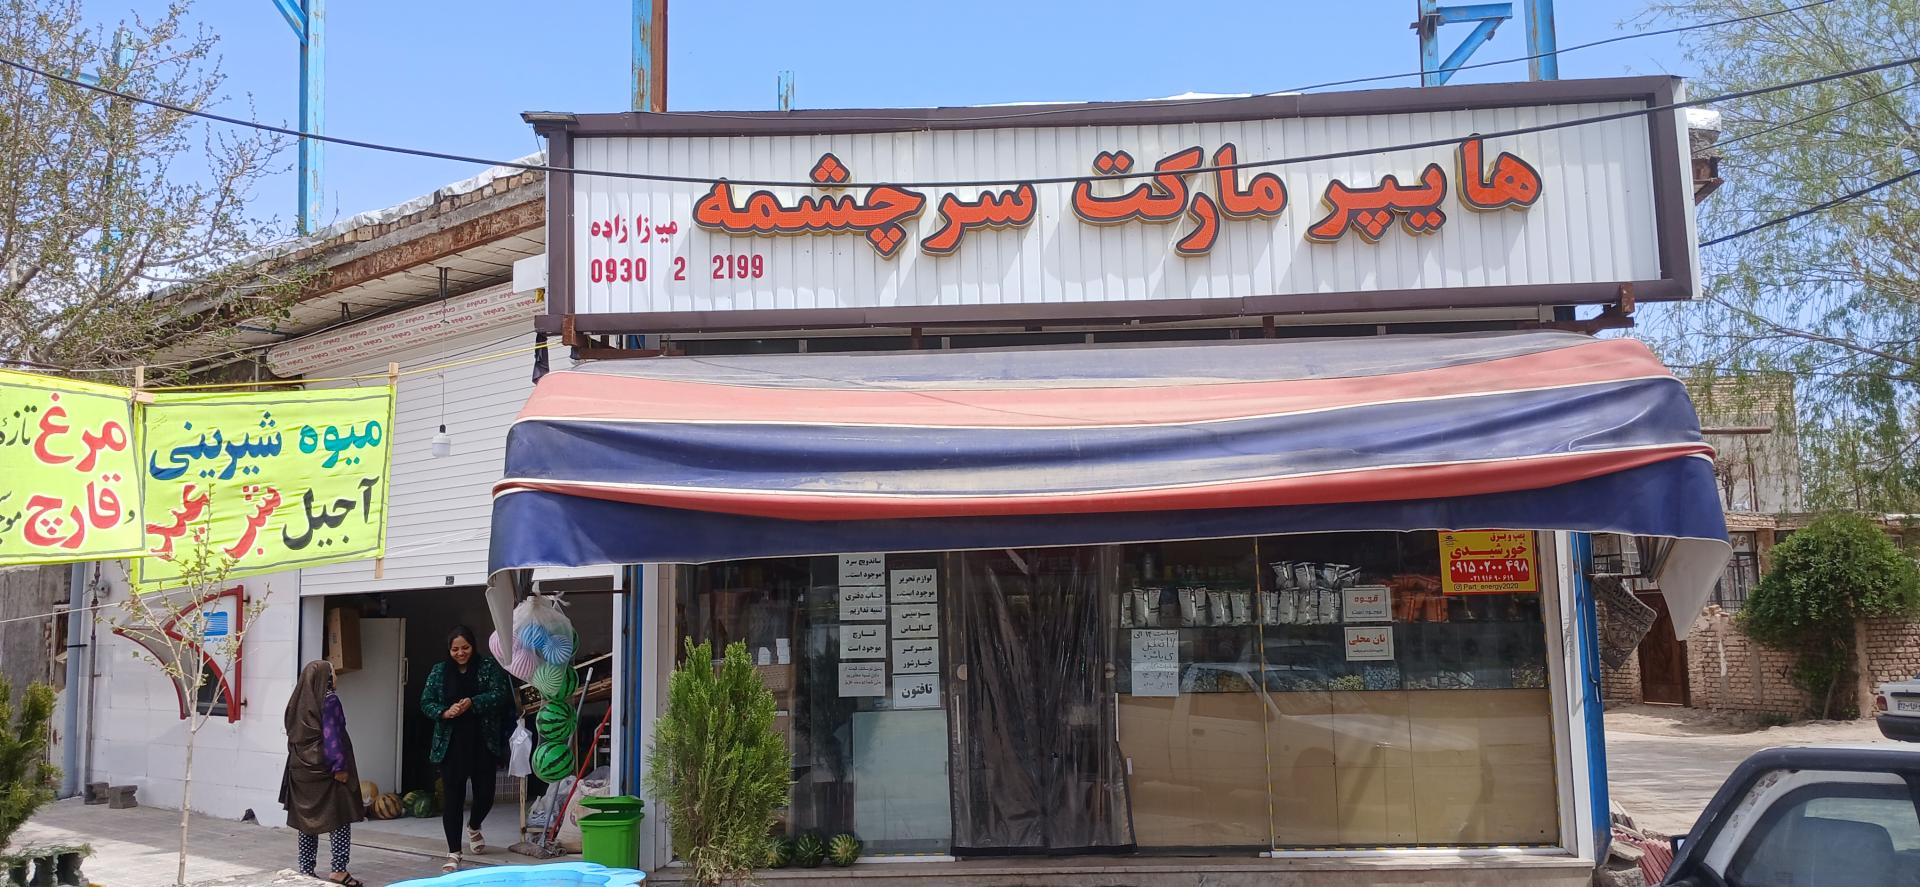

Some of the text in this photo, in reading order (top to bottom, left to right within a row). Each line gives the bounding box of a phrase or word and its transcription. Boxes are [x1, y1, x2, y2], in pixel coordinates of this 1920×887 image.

[1071, 142, 1289, 257] مارکت
[1304, 132, 1544, 245] هایپر
[591, 254, 764, 283] 0930 2 2199
[34, 392, 127, 472] مرغ
[148, 410, 383, 481] میوه شیرینی
[23, 473, 122, 550] قارچ
[281, 475, 381, 551] آجیل
[1450, 542, 1527, 559] خورشیدی
[1451, 560, 1476, 573] ۰۹۱۵
[1505, 560, 1529, 573] ۴۹۸
[916, 575, 932, 584] لوازم
[852, 629, 877, 639] قارچ
[901, 623, 932, 633] کالباس
[1348, 633, 1386, 645] نان محلی
[901, 682, 933, 698] تافتون
